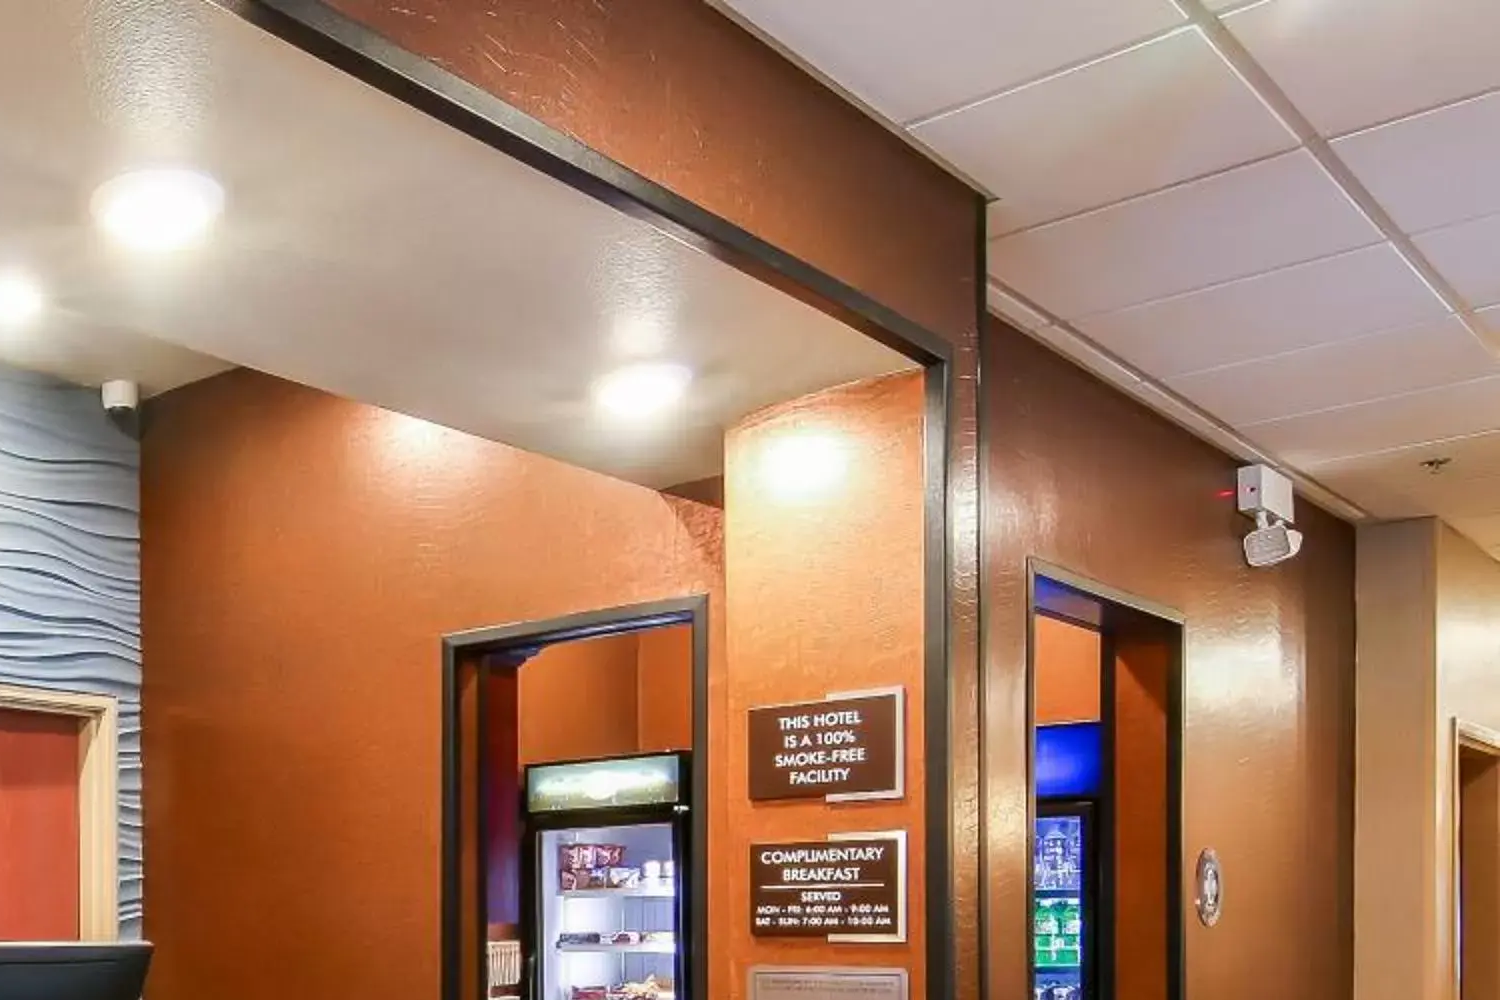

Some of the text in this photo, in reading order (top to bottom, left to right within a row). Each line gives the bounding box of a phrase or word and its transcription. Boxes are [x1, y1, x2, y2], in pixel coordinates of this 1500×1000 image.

[778, 711, 862, 731] THIS HOTEL
[784, 730, 856, 749] IS A 100%
[774, 748, 866, 767] SMOKE-FREE
[789, 768, 851, 785] FACILITY
[760, 847, 884, 865] COMPLIMENTARY
[782, 867, 861, 881] BREAKFAST
[800, 891, 841, 903] SERVED
[756, 905, 780, 914] MON
[827, 905, 842, 913] AM
[873, 904, 889, 913] AM
[823, 917, 839, 925] AM
[875, 916, 891, 925] AM
